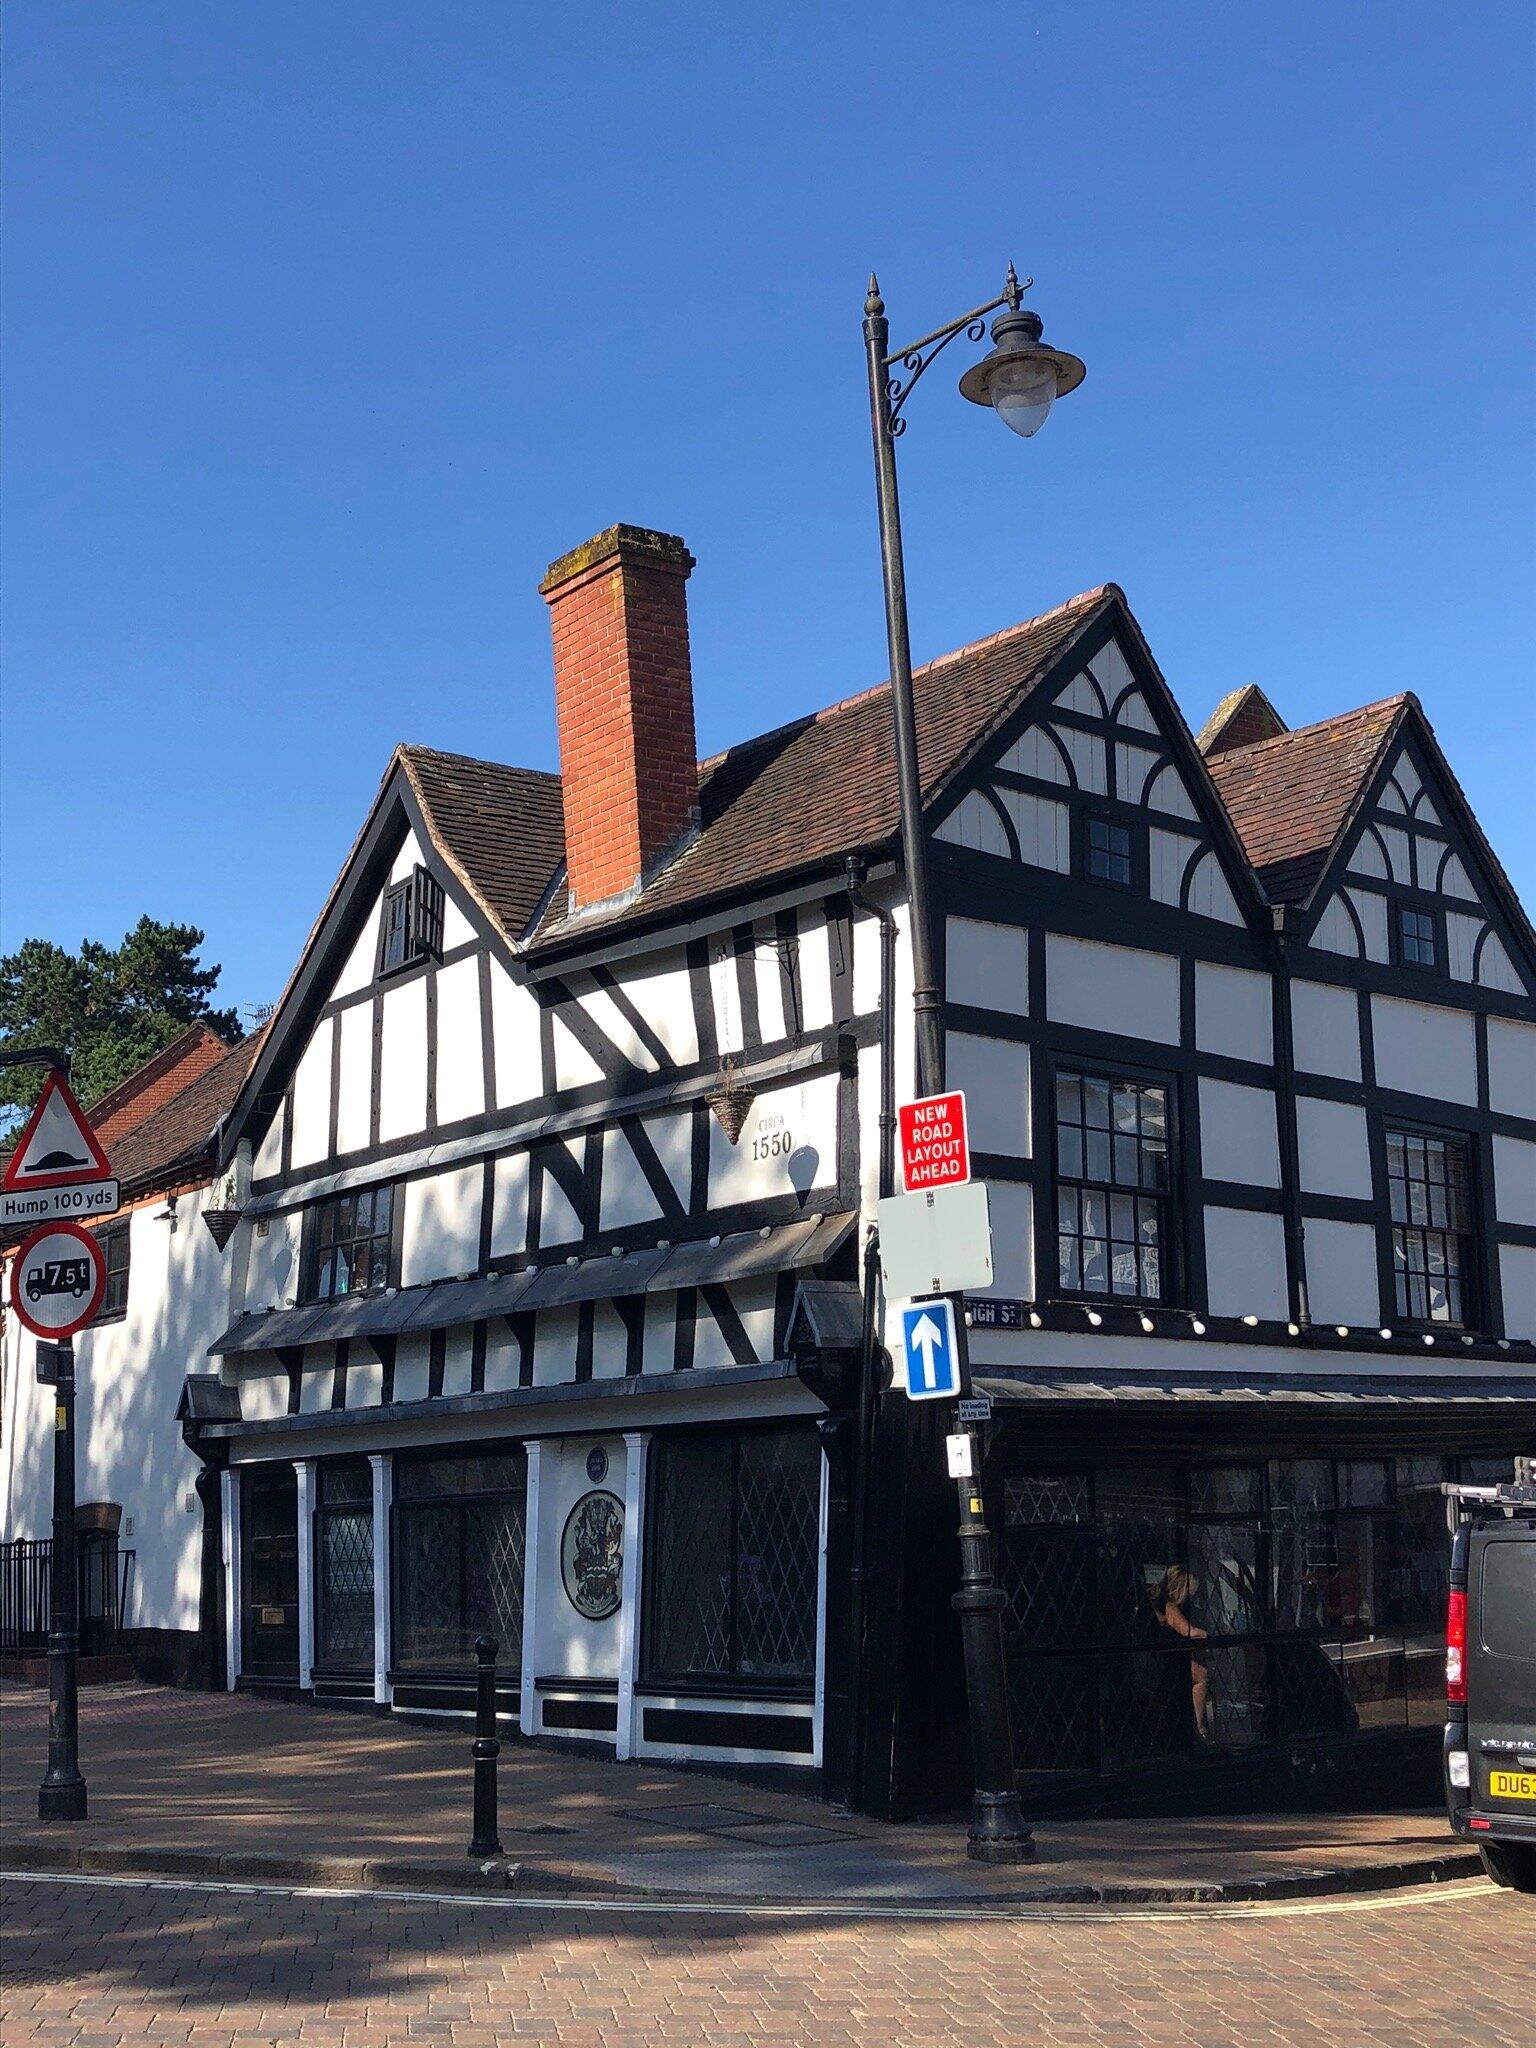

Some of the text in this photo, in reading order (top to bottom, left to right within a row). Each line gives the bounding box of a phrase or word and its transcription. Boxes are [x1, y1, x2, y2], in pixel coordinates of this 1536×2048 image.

[758, 1115, 785, 1131] CIRCA
[914, 1103, 948, 1124] NEW
[912, 1122, 953, 1144] ROAD
[752, 1131, 792, 1161] 1550
[907, 1139, 961, 1164] LAYOUT
[911, 1159, 960, 1183] AHEAD
[5, 1189, 113, 1215] Hump 100 yds
[48, 1262, 87, 1287] 7.5t
[972, 1303, 996, 1323] IGH
